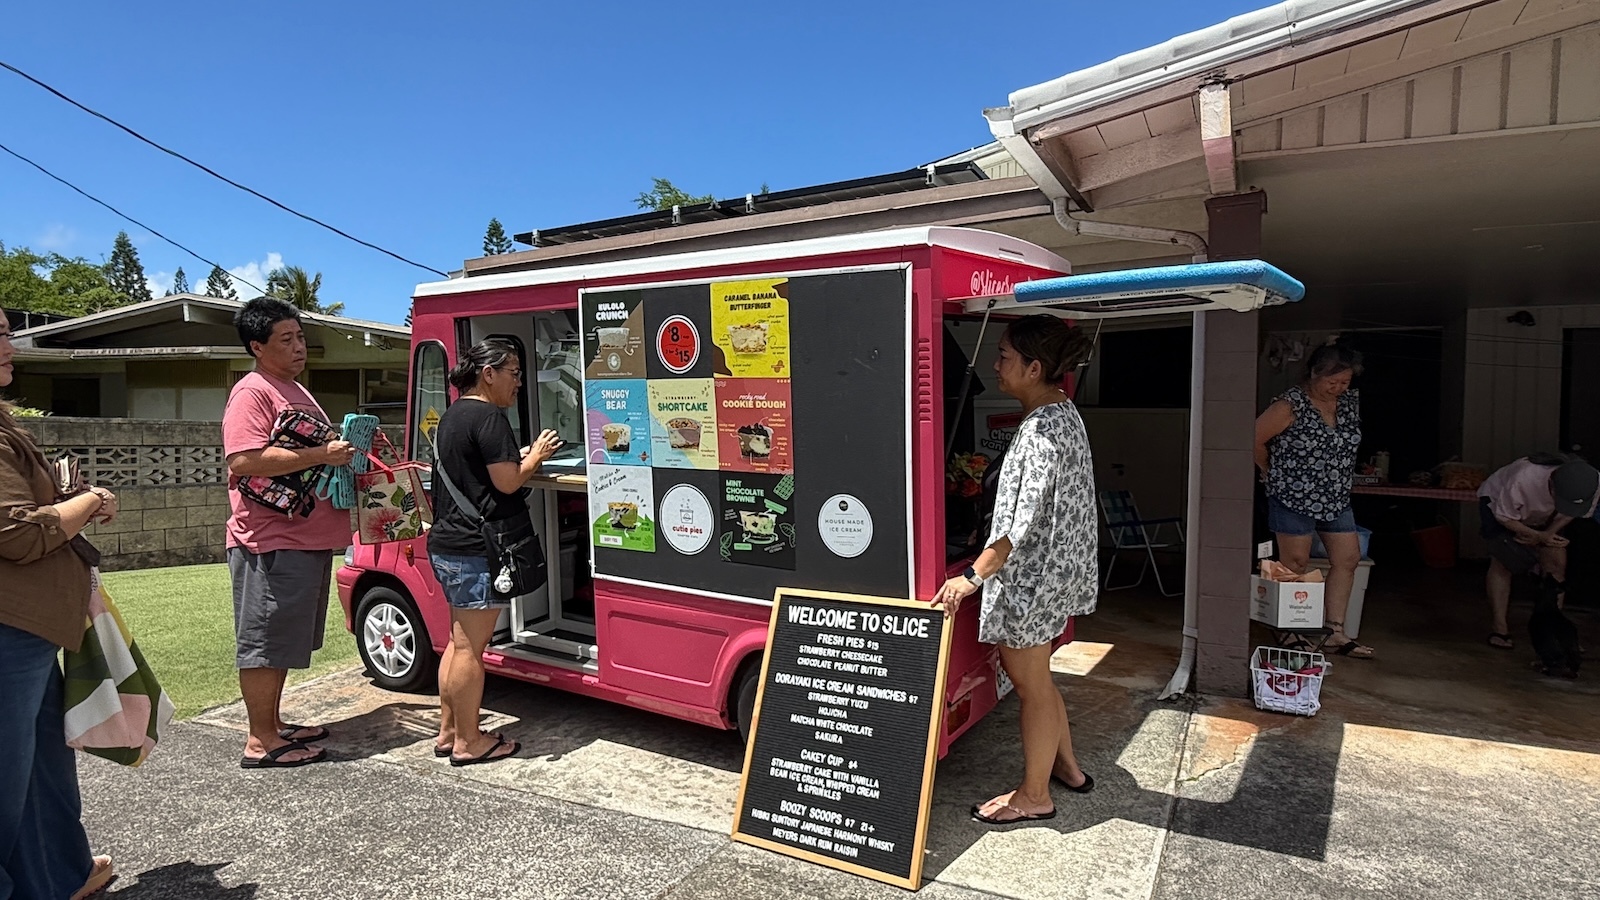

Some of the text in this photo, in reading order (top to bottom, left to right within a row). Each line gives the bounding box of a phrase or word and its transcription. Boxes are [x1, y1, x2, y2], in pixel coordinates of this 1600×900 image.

[724, 292, 777, 302] CARAMEL BANANA
[598, 302, 625, 311] KULOLO
[729, 302, 771, 312] BUTTERFINGER
[596, 310, 629, 321] CRUNCH
[601, 389, 630, 400] SNUGGY
[739, 392, 768, 401] rocky road
[606, 400, 627, 410] BEAR
[658, 402, 708, 412] SHORTCAKE
[722, 400, 786, 409] COOKIE DOUGH
[726, 479, 742, 488] MINT
[726, 486, 765, 497] CHOCOLATE
[726, 495, 756, 504] BROWNIE
[672, 525, 703, 535] cutie pies
[788, 605, 930, 638] WELCOME TO SLICE
[817, 633, 879, 651] FRESH PIES $15
[799, 645, 883, 664] STRAWBERRY CHEESECAKE
[797, 657, 888, 677] CHOCOLATE PEANUT BUTTER
[775, 672, 918, 705] DORAYAKI ICE CREAM SANDWICHES $7
[808, 692, 869, 710] STRAWBERRY YUZU
[818, 706, 848, 719] HOJICHA
[790, 714, 874, 737] MATCHA WHITE CHOCOLATE
[814, 730, 843, 744] SAKURA
[800, 748, 858, 770] CAKEY CUP $4
[770, 758, 880, 788] STRAWBERRY CAKE WITH VANILLA
[770, 767, 880, 799] BEAN ICE CREAM, WHIPPED CREAM
[796, 783, 842, 801] & SPRINKLES
[780, 800, 876, 833] BOOZY SCOOPS $7 21+
[771, 812, 800, 828] SUNTORY
[800, 820, 832, 838] JAPANESE
[834, 828, 868, 846] HARMONY
[868, 836, 895, 852] WHISKY
[772, 827, 858, 858] MEYERS DARK RUM RAISIN
